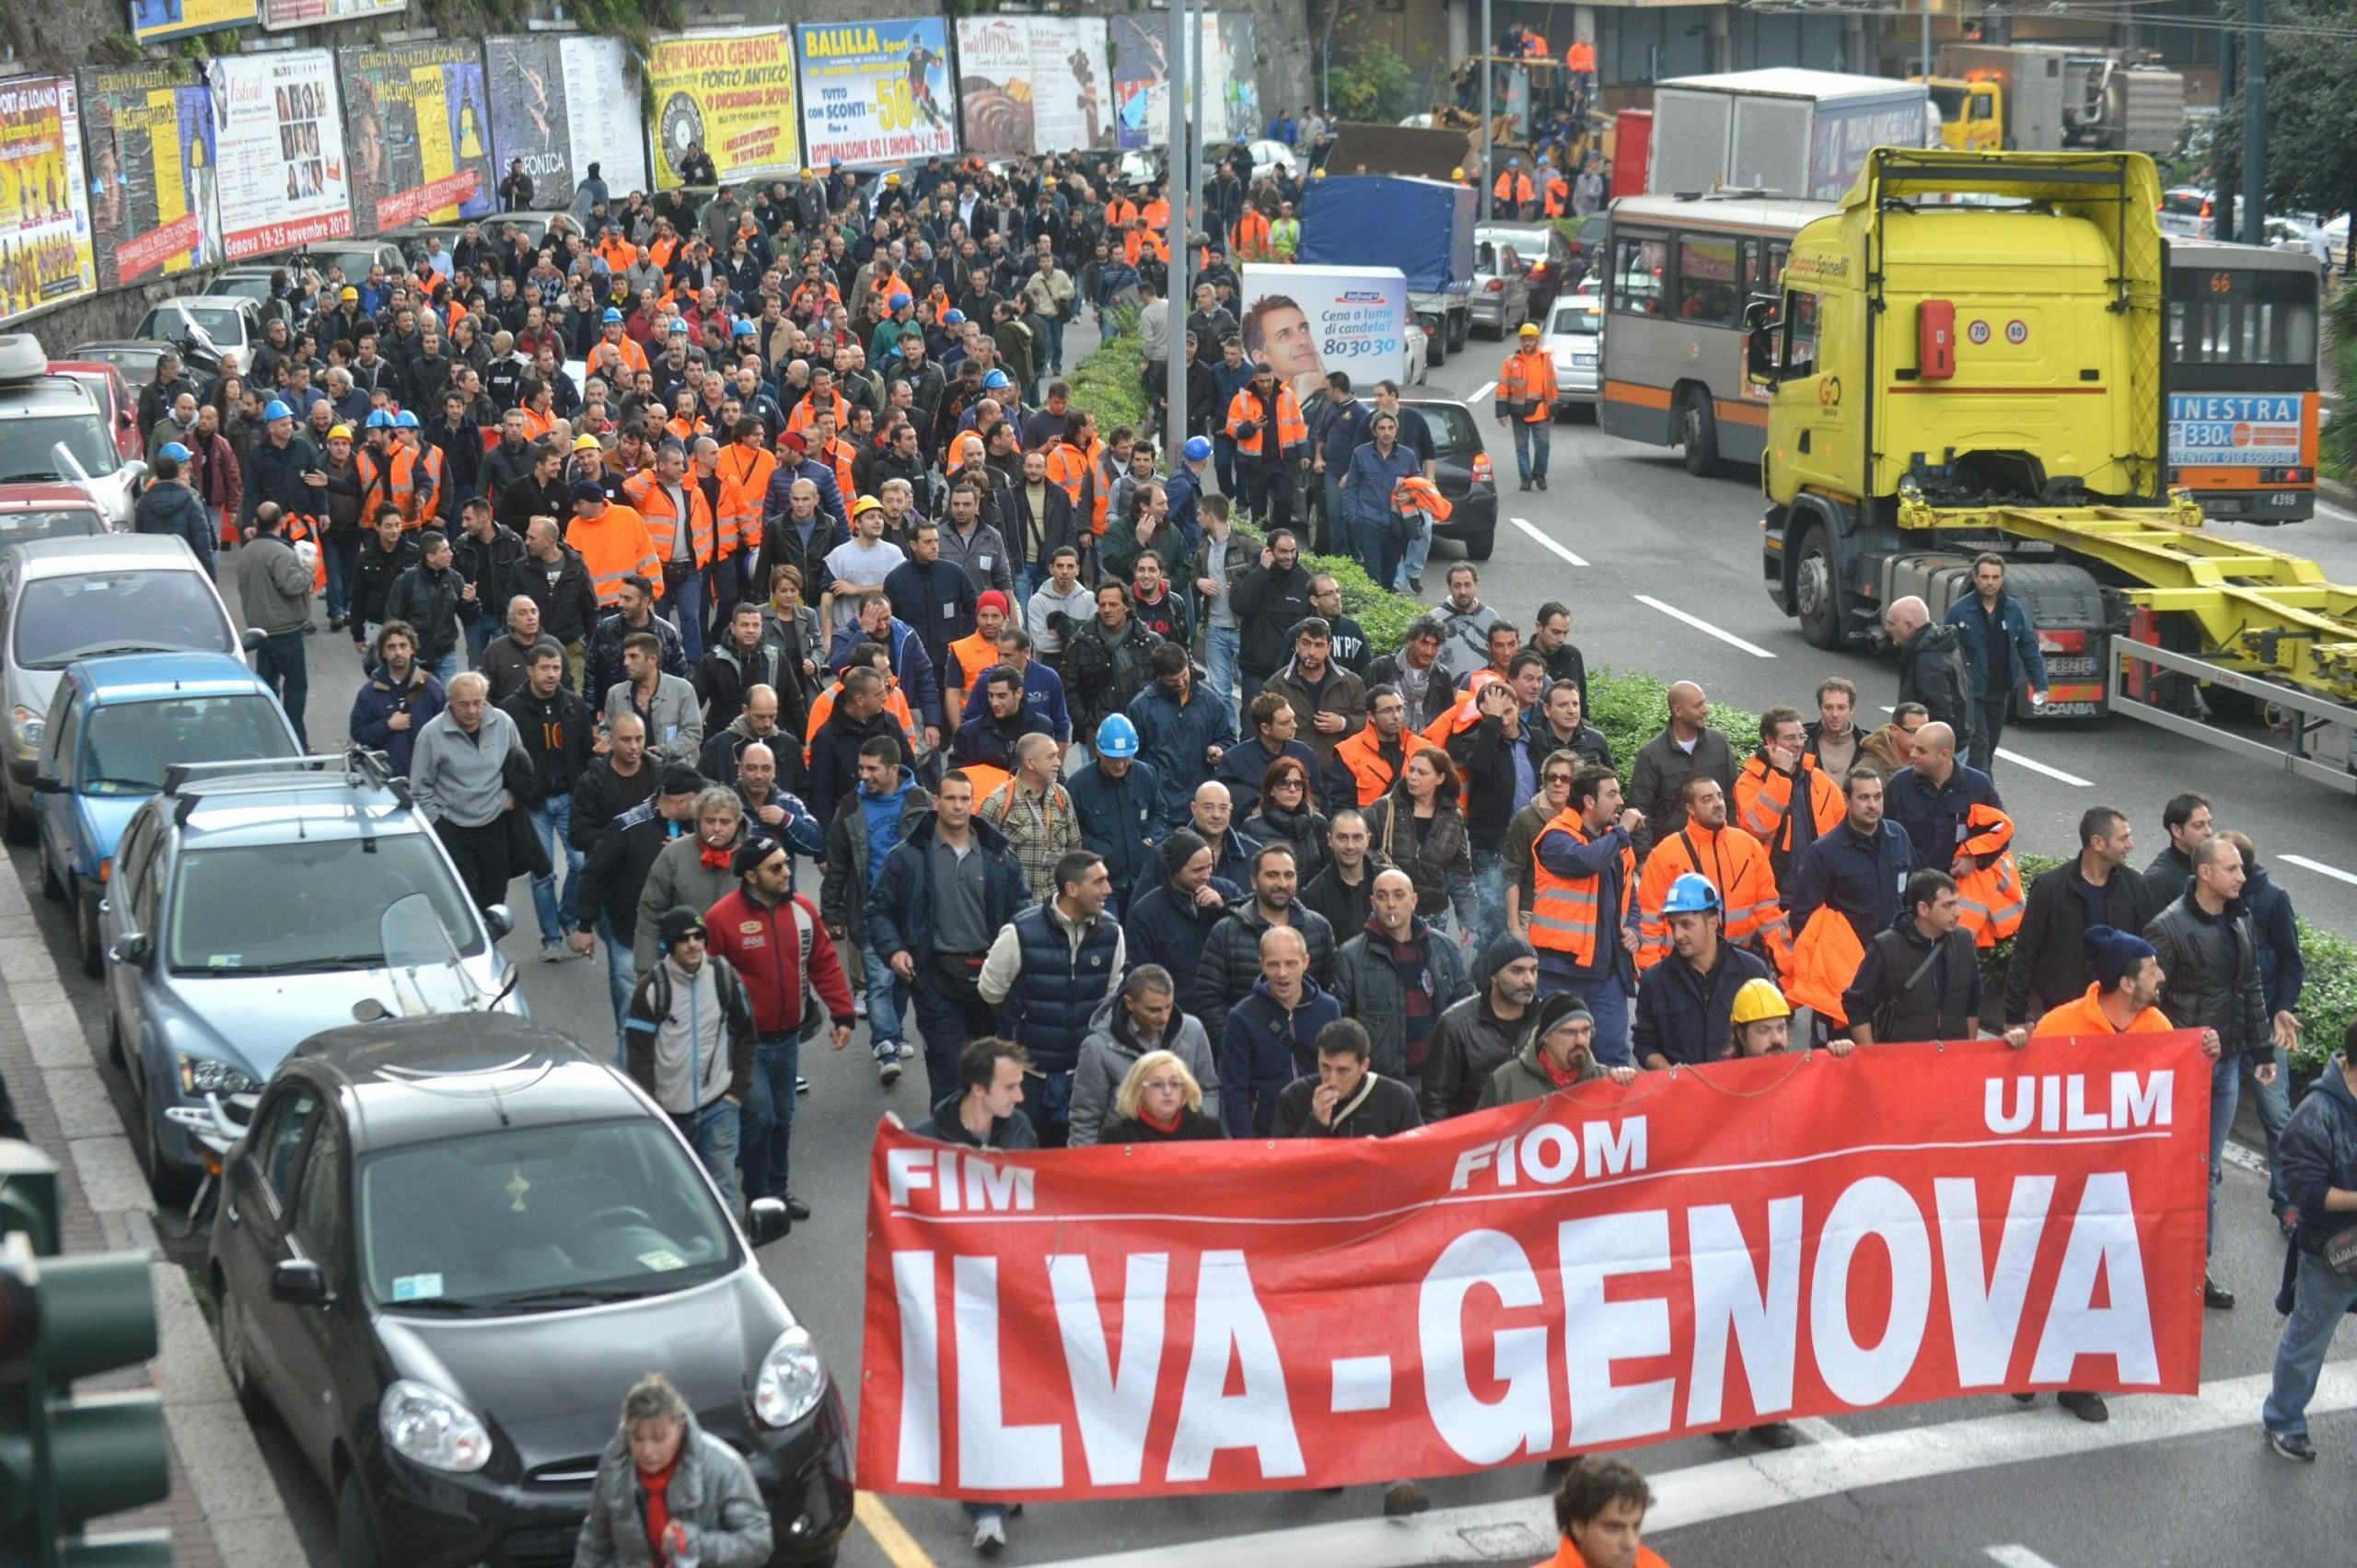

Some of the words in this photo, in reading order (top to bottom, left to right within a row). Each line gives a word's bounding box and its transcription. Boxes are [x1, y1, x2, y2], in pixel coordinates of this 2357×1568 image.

[685, 42, 725, 67] DISCO
[727, 37, 779, 64] GENOVA
[805, 28, 879, 58] BALILLA
[882, 39, 908, 55] Sport
[359, 52, 392, 69] GENOVA
[395, 49, 429, 66] PALAZZO
[432, 46, 464, 63] DUCALE
[98, 74, 129, 92] GENOVA
[131, 70, 167, 89] PALAZZO
[701, 69, 742, 88] PORTO
[743, 64, 789, 85] ANTICO
[18, 89, 29, 111] di
[28, 86, 57, 110] LOANO
[377, 79, 413, 109] McCurry
[705, 94, 714, 111] 9
[821, 87, 847, 99] TUTTO
[807, 107, 824, 119] CON
[826, 101, 865, 120] SCONTI
[811, 139, 868, 164] ROTTAMAZIONE
[870, 138, 881, 157] SCI
[504, 152, 565, 176] SFONICA
[417, 183, 443, 202] BIGLIETTO
[443, 173, 474, 195] CONGIUNTO
[225, 235, 259, 257] Genova
[259, 226, 285, 250] 19-25
[286, 222, 328, 244] novembre
[329, 214, 351, 234] 2012
[2212, 273, 2230, 292] 66
[1321, 309, 1352, 322] Cena
[1353, 310, 1362, 320] a
[1364, 308, 1394, 319] lume
[1325, 323, 1337, 335] di
[1339, 320, 1393, 334] candela?
[1974, 326, 1986, 337] 70
[2010, 326, 2023, 337] 80
[2173, 398, 2291, 421] INESTRA
[2223, 451, 2244, 463] 010
[2270, 494, 2296, 506] 4319
[2032, 703, 2096, 715] SCANIA
[799, 928, 811, 958] TEAM
[1984, 1070, 2174, 1134] UILM
[1450, 1114, 1648, 1191] FIOM
[887, 1148, 1036, 1211] FIM
[890, 1249, 1307, 1489] ILVA
[1418, 1171, 2161, 1466] GENOVA
